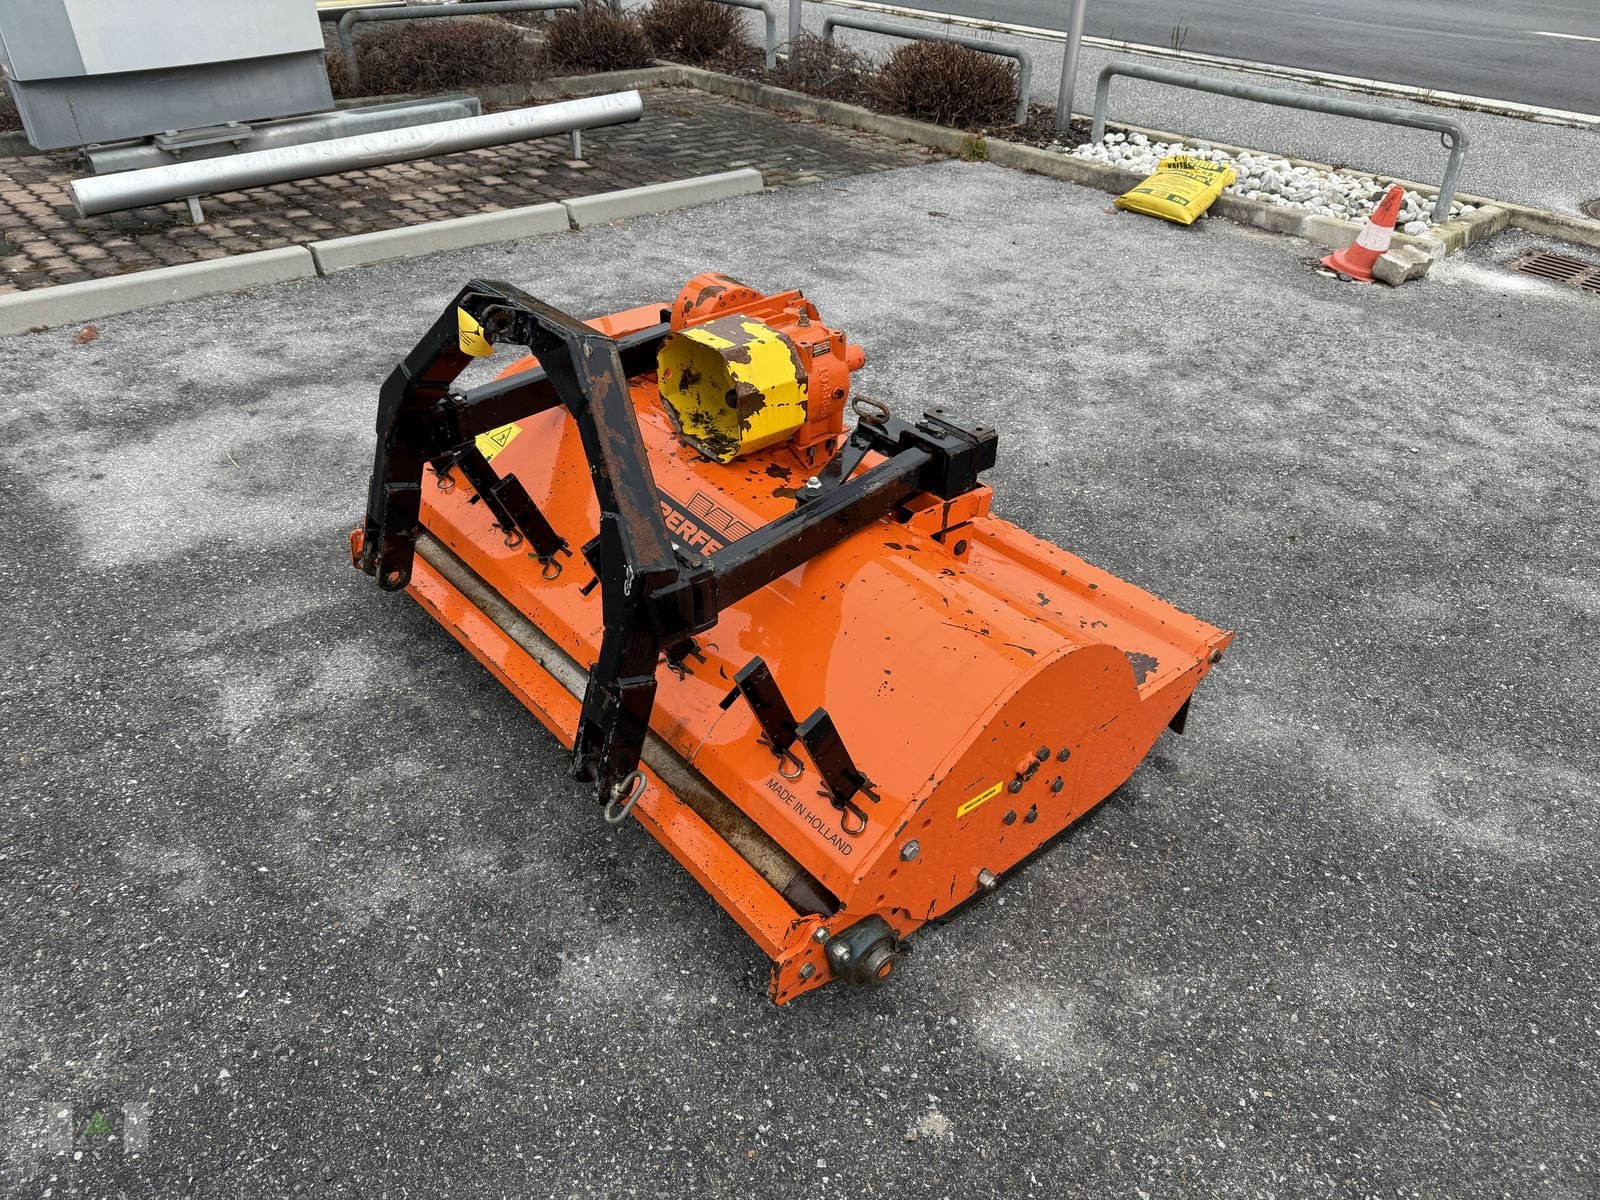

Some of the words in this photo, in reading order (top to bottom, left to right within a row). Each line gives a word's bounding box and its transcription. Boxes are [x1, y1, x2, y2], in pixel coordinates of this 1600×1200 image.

[766, 778, 796, 806] MADE
[793, 801, 807, 816] IN
[804, 811, 853, 856] HOLLAND
